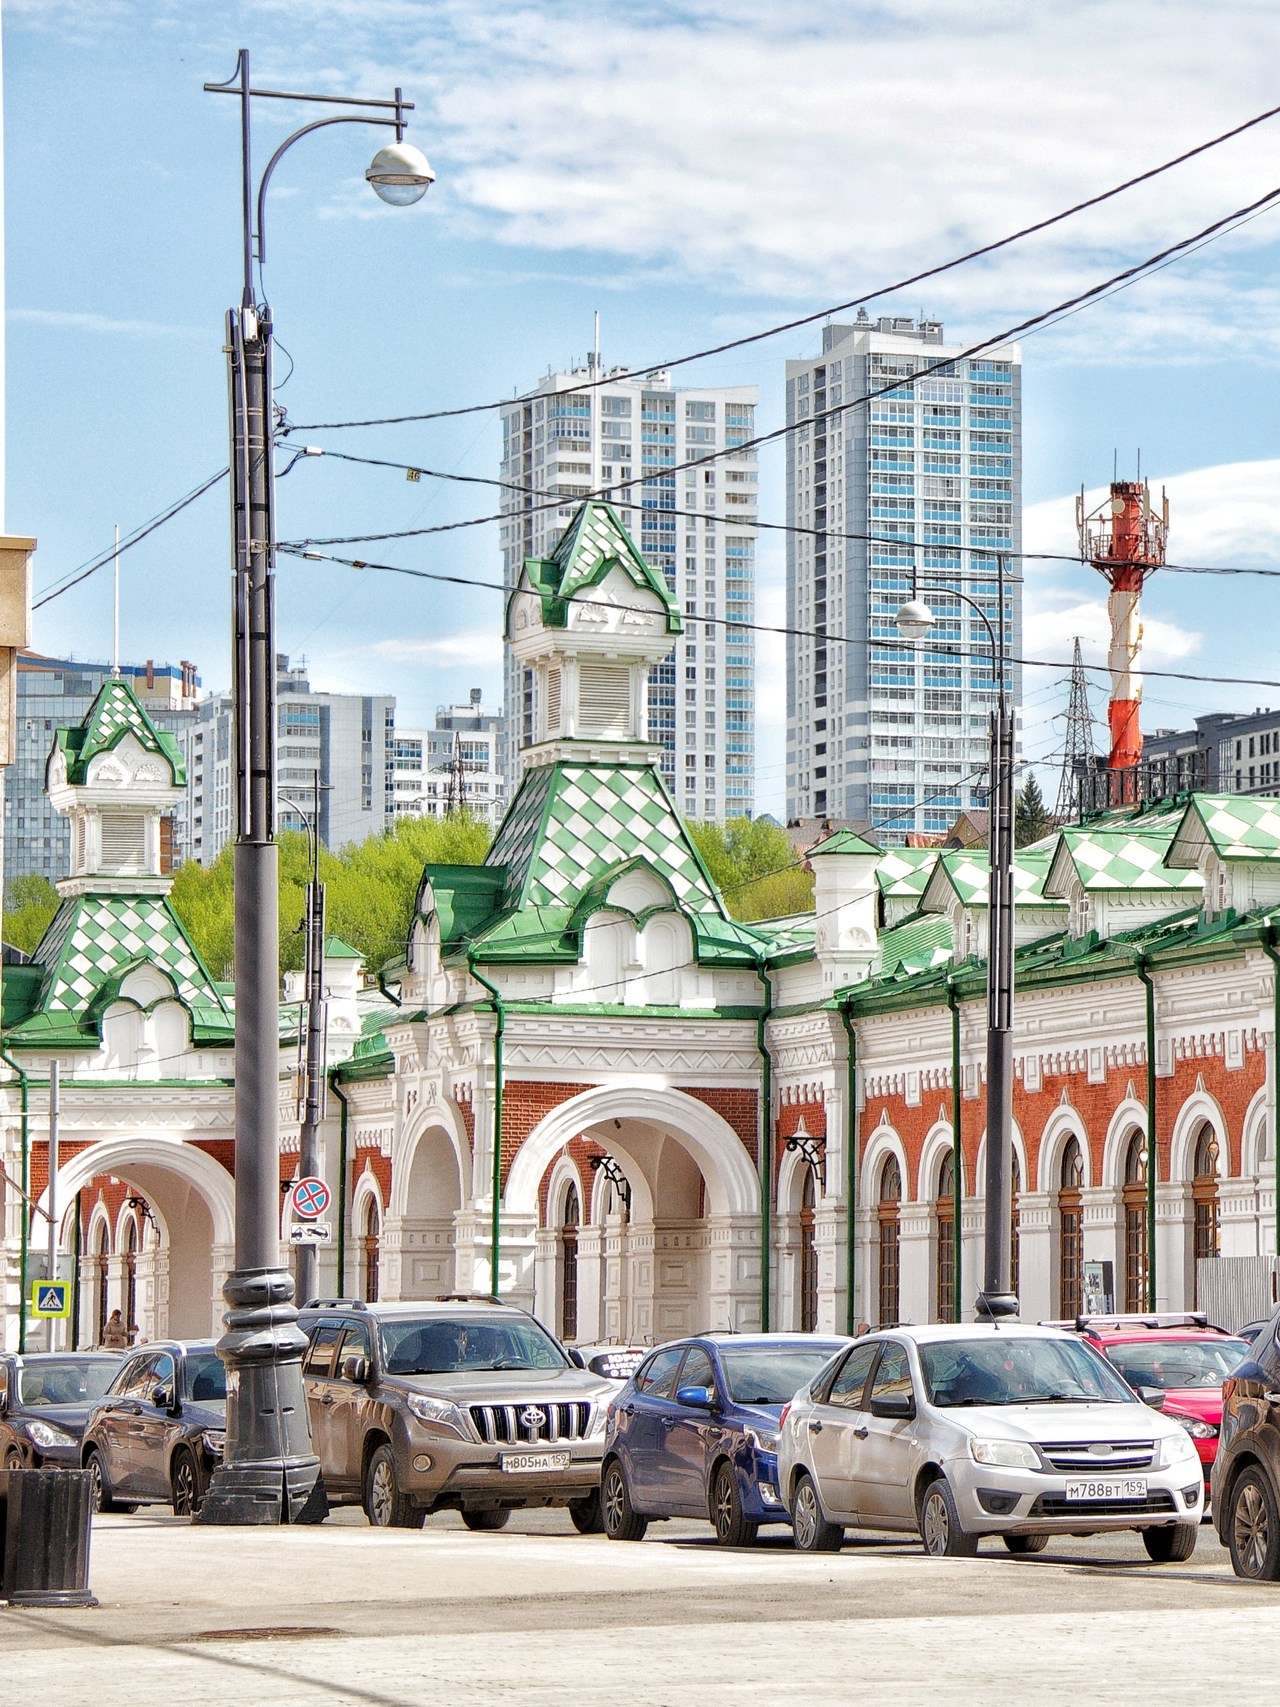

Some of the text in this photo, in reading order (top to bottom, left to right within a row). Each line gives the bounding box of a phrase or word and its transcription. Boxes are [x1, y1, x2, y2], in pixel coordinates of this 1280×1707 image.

[550, 1454, 567, 1464] 159
[1070, 1481, 1143, 1498] М788ВТ 159
